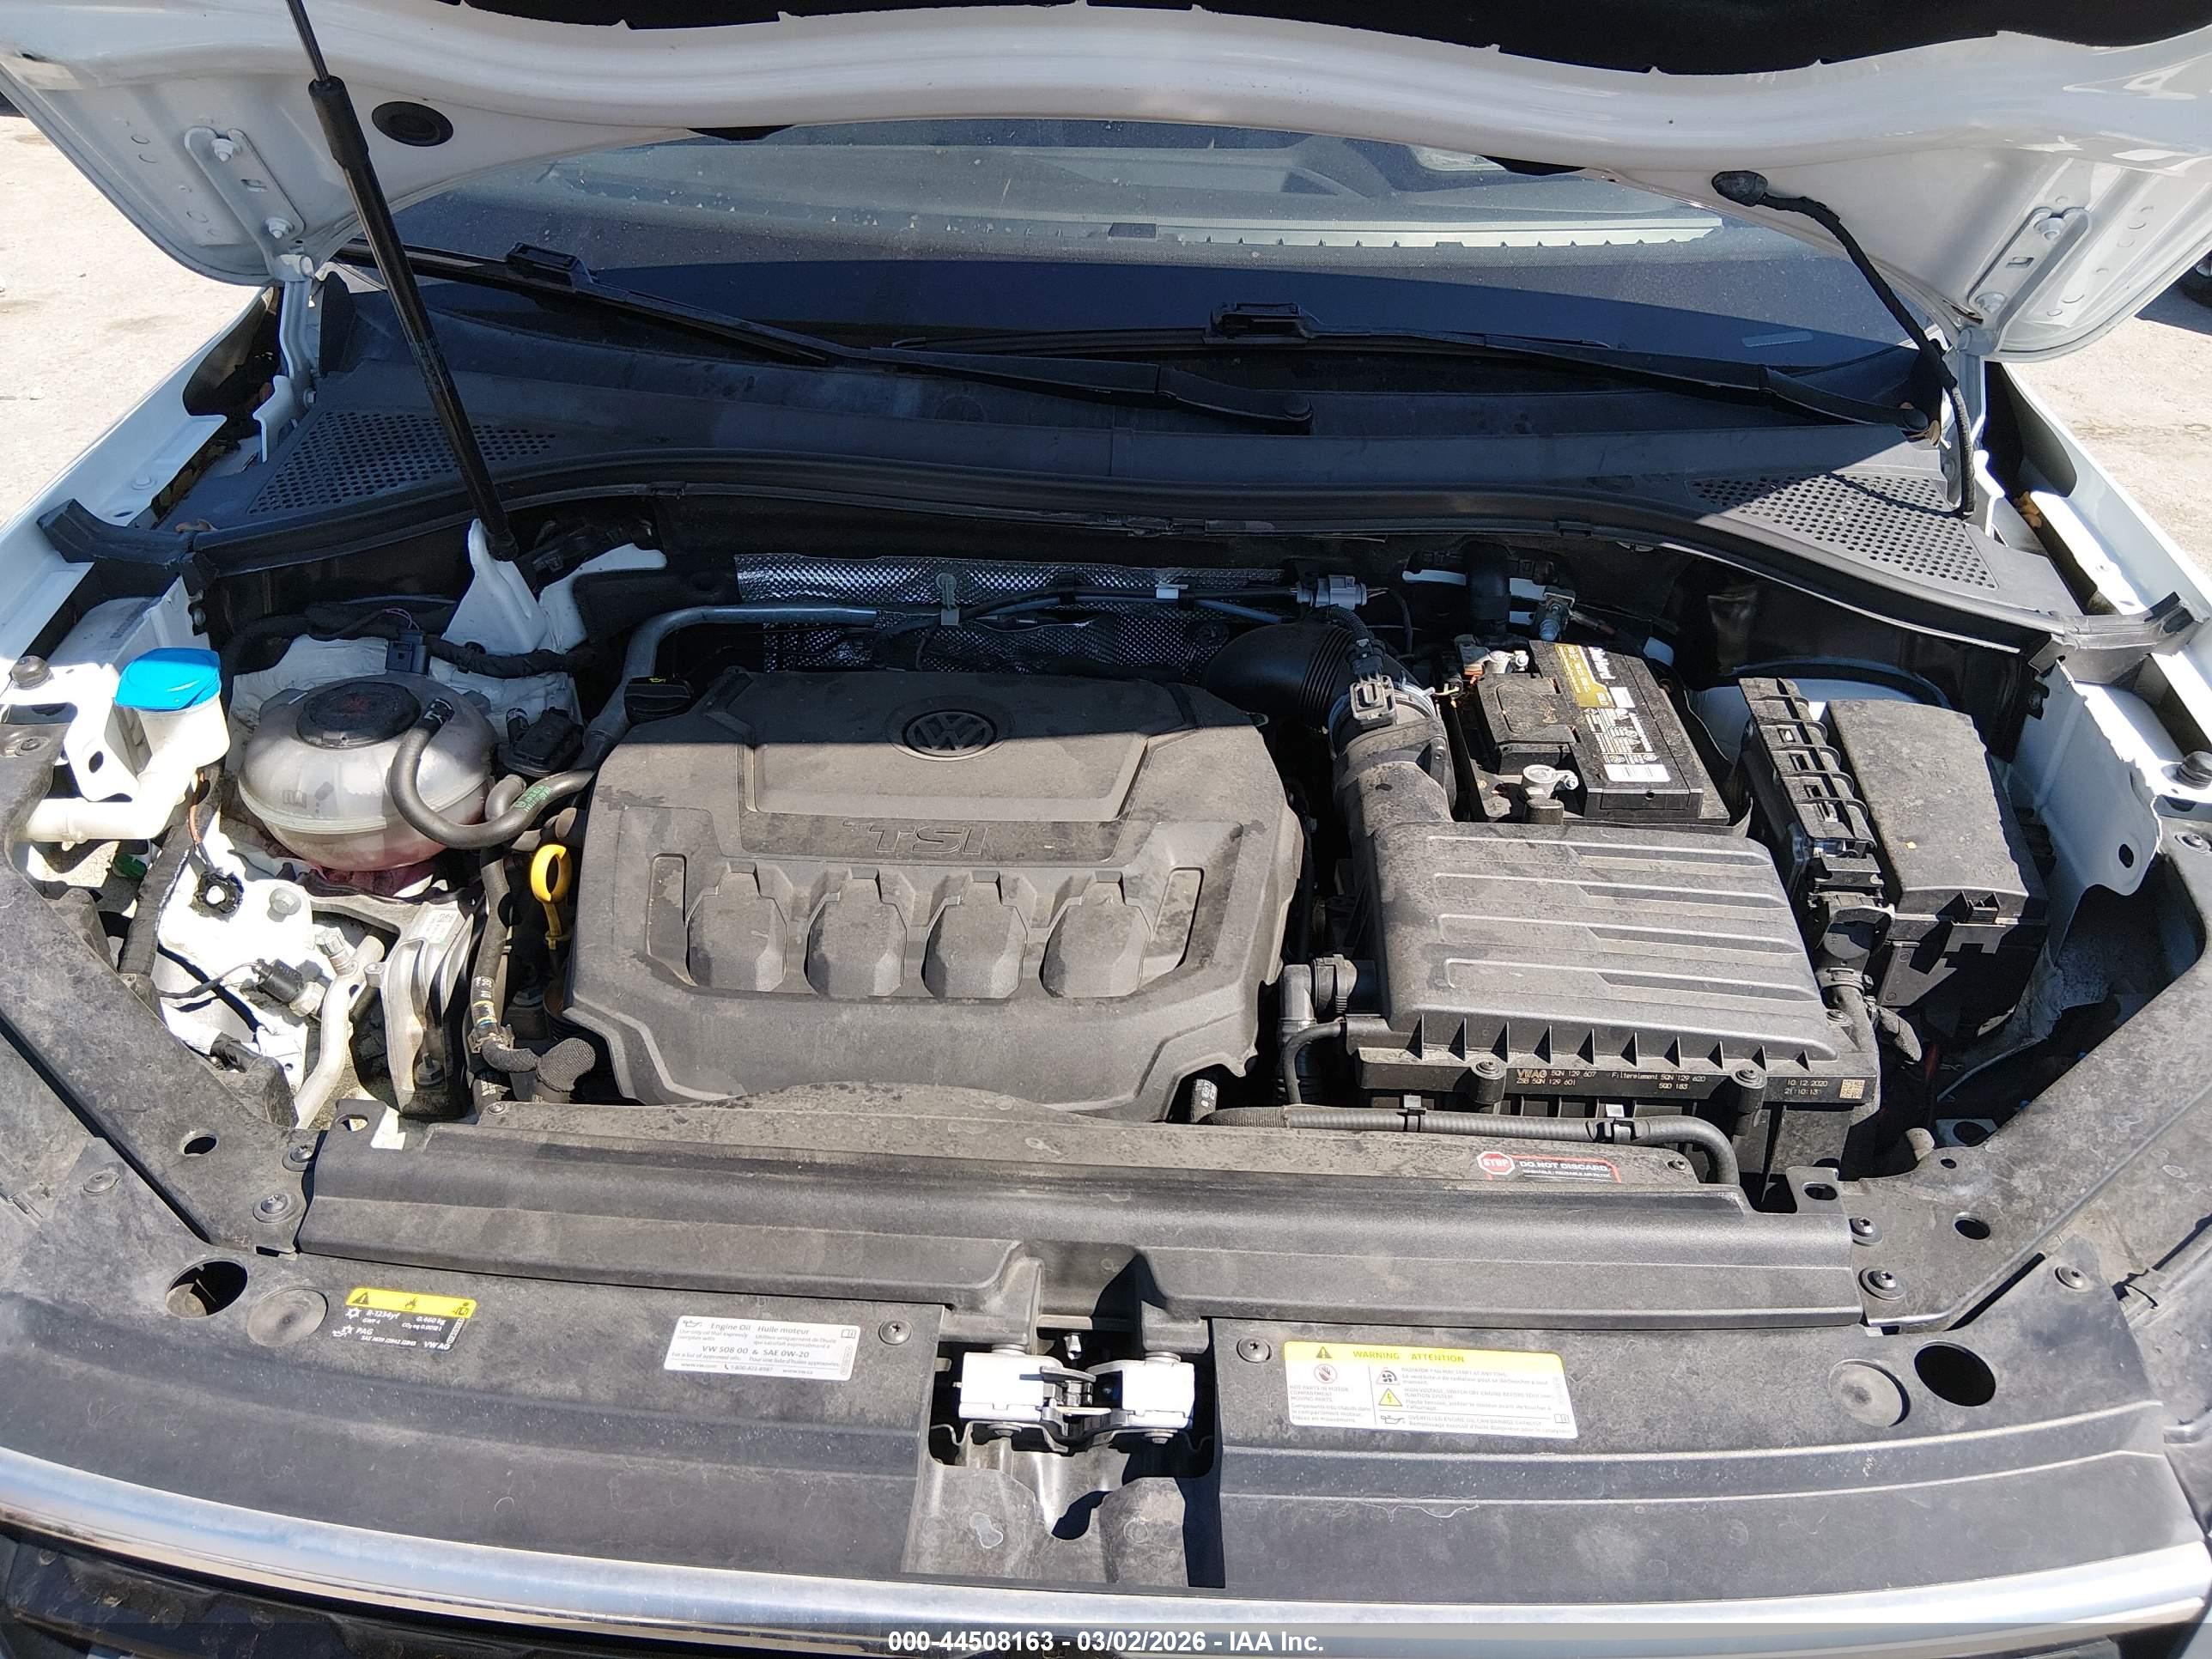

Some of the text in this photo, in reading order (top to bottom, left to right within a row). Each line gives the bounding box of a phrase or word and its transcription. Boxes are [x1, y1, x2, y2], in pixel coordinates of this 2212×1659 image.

[868, 823, 988, 855] TSI
[1516, 1069, 1547, 1079] VWAG
[1352, 1352, 1400, 1360] WARNING
[1411, 1353, 1464, 1362] ATTENTION
